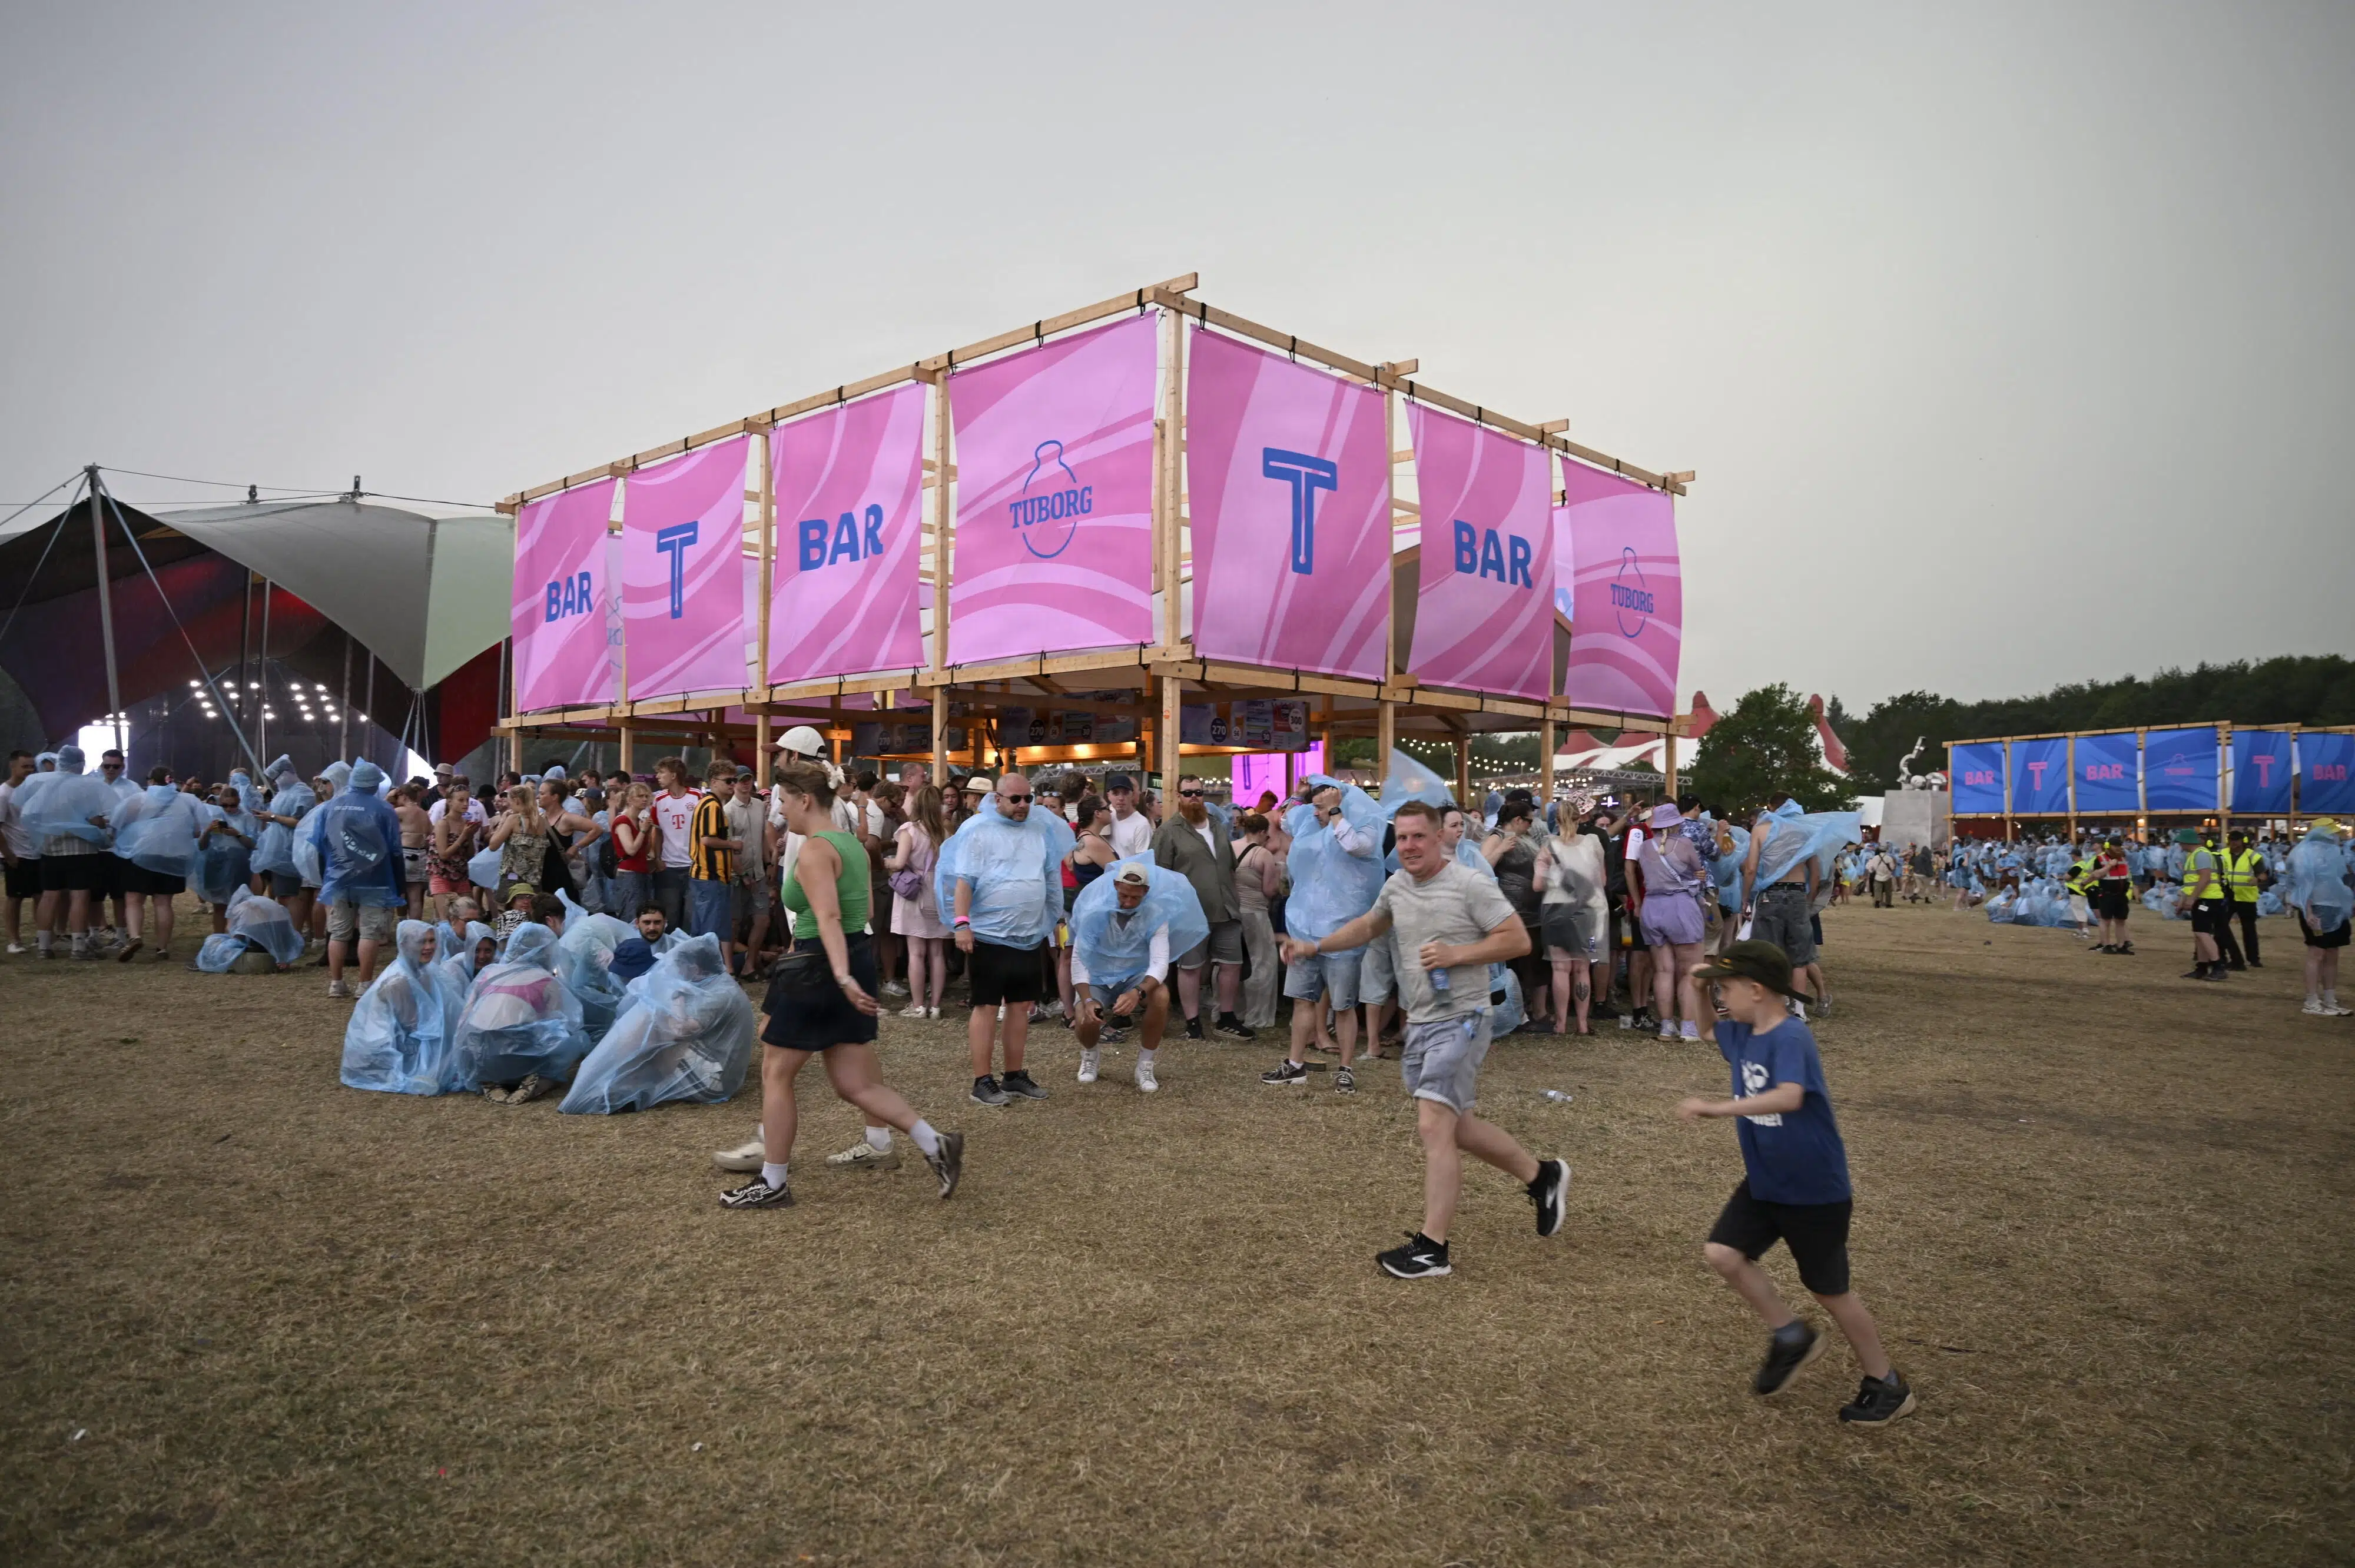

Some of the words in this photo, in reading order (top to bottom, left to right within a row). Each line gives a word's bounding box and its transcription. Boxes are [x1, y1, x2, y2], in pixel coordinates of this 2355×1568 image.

[1010, 486, 1093, 529] TUBORG
[1262, 447, 1338, 575] T
[799, 503, 884, 572] BAR
[656, 520, 699, 619] T
[1453, 520, 1533, 589] BAR
[545, 571, 593, 623] BAR
[1611, 582, 1654, 614] TUBORG
[1030, 727, 1044, 736] 270
[1212, 725, 1226, 736] 270
[1965, 770, 1994, 785] BAR
[2028, 761, 2048, 790] T
[2086, 763, 2123, 780] BAR
[2253, 755, 2275, 788] T
[2313, 765, 2346, 780] BAR
